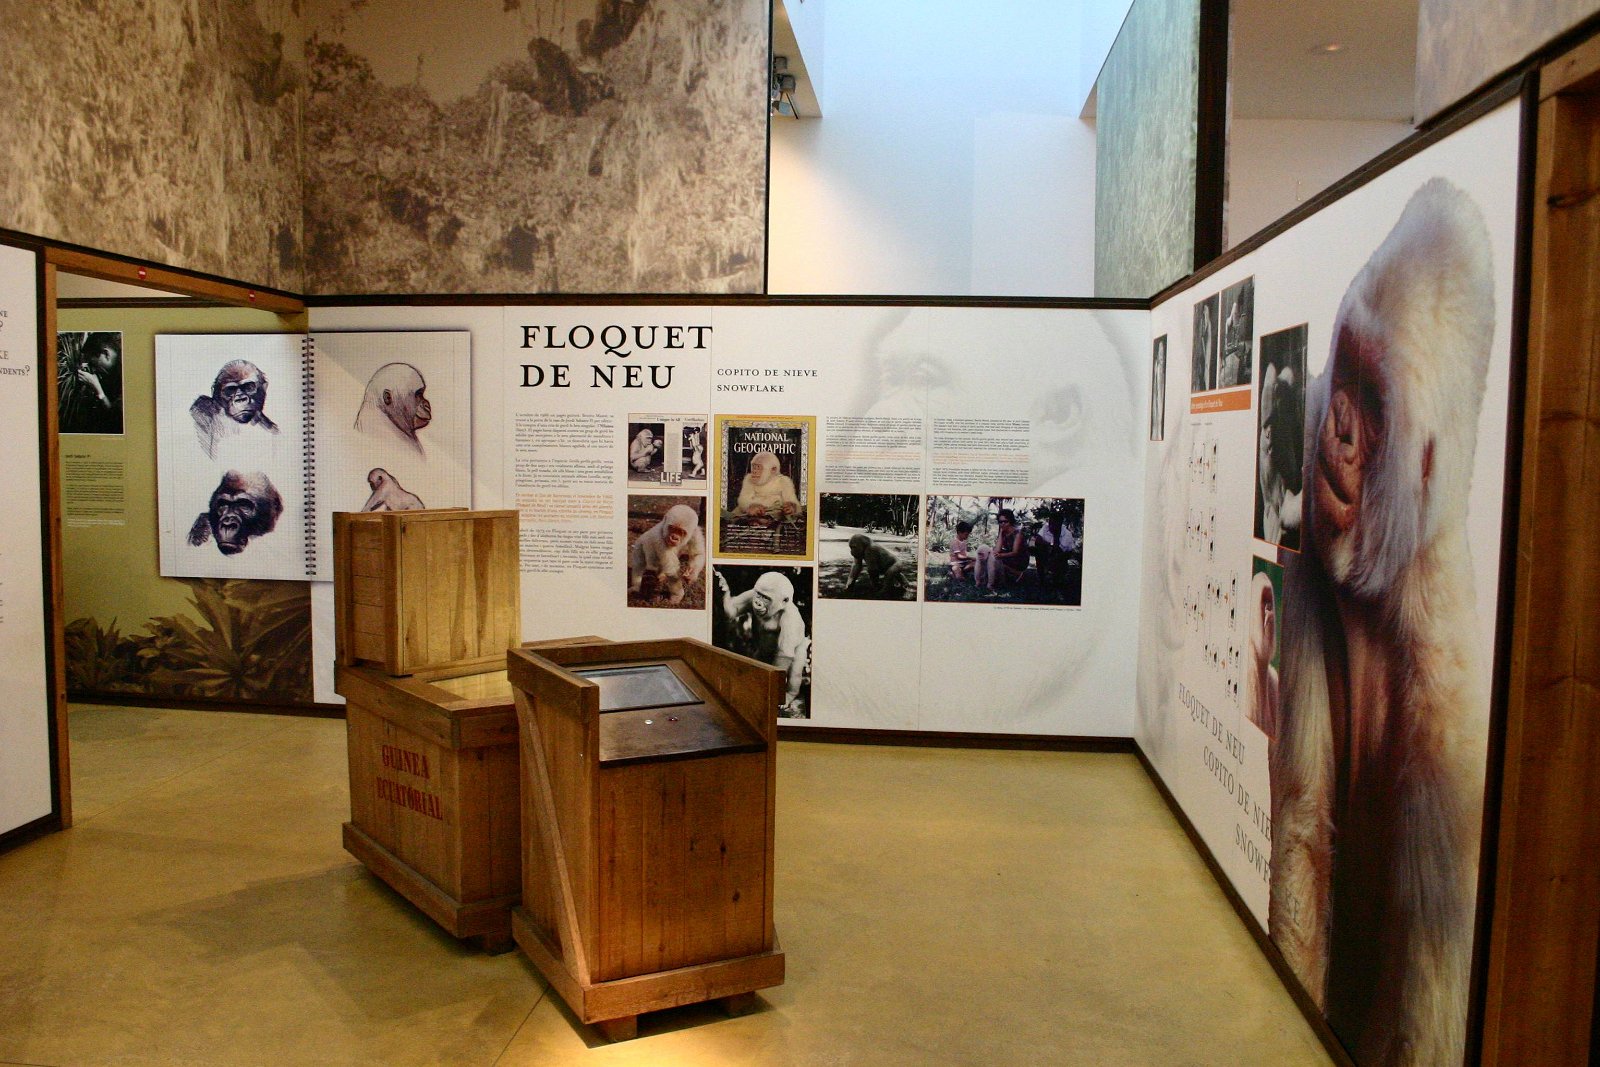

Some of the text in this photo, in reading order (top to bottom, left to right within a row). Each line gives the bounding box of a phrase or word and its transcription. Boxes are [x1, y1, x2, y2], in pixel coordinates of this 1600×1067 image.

[520, 325, 713, 358] FLOQUET
[520, 364, 676, 389] DE NEU
[717, 368, 818, 377] COPITO DE NIEVE
[717, 383, 785, 393] SNOWFLAKE
[744, 432, 789, 443] NATIONAL
[733, 442, 796, 455] GEOGRAPHIC
[660, 471, 682, 484] LIFE
[1178, 682, 1246, 765] FLOQUET DE NEU
[382, 744, 430, 779] GUINEA
[1203, 745, 1235, 796] COPITO
[1237, 782, 1249, 815] DE
